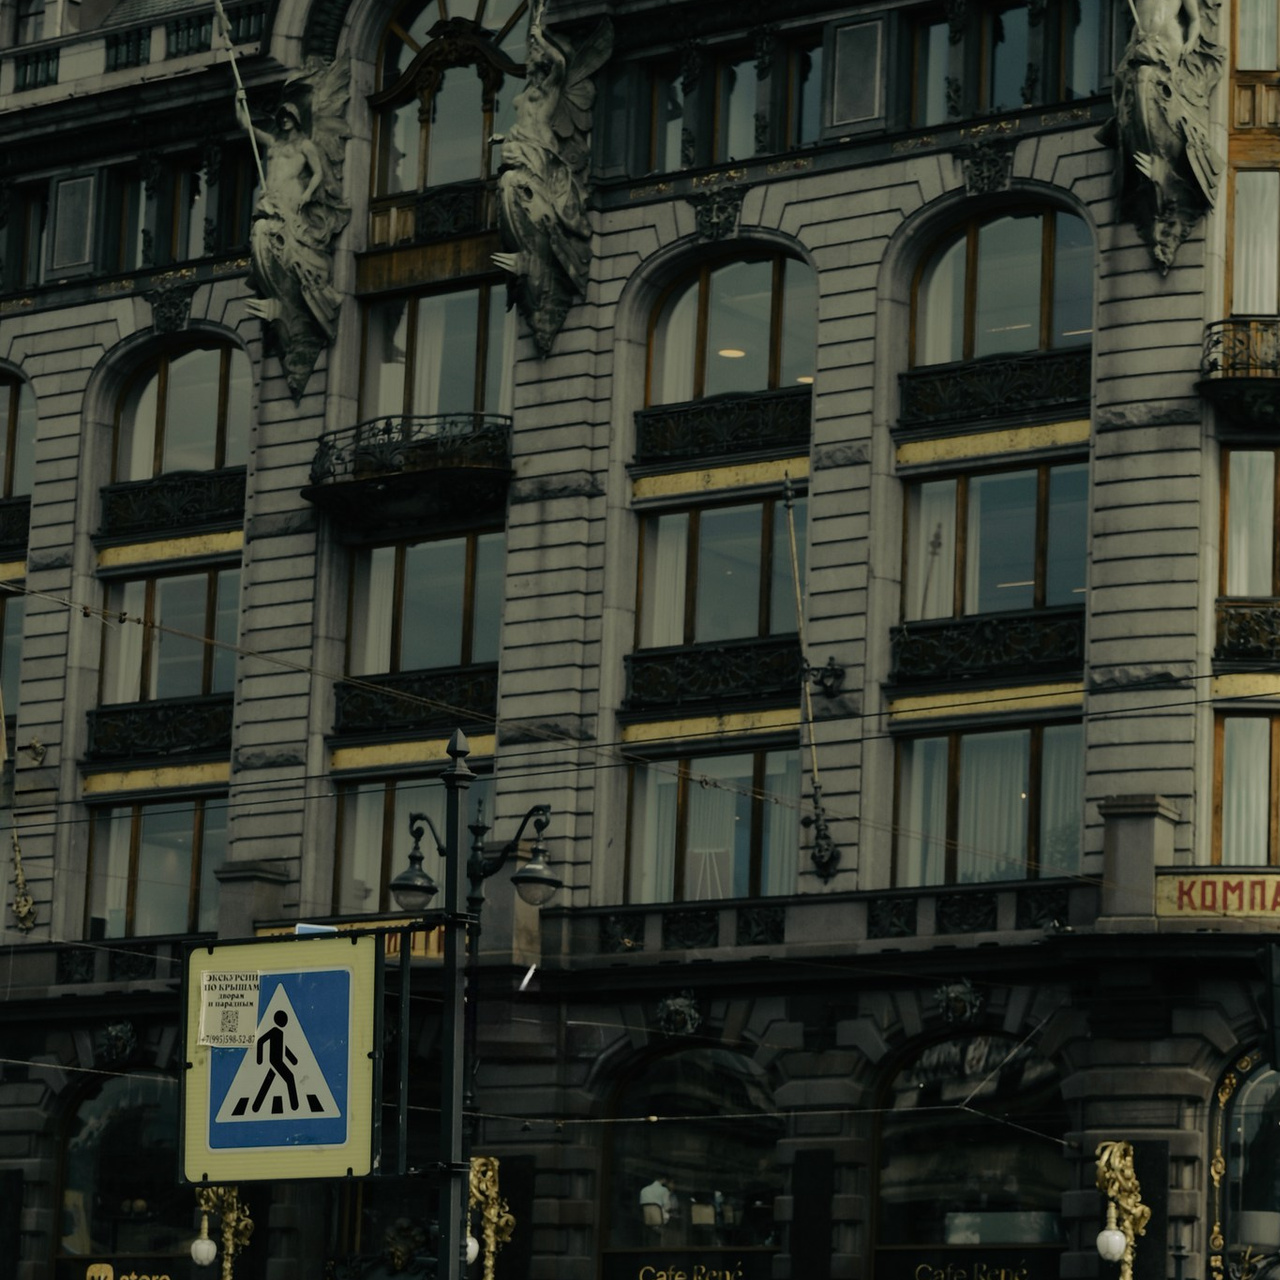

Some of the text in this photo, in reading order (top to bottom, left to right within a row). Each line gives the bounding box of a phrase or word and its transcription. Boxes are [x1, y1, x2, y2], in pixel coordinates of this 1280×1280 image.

[205, 974, 259, 982] ЭКСКУРСИИ
[204, 983, 260, 991] ПО КРЫШАМ
